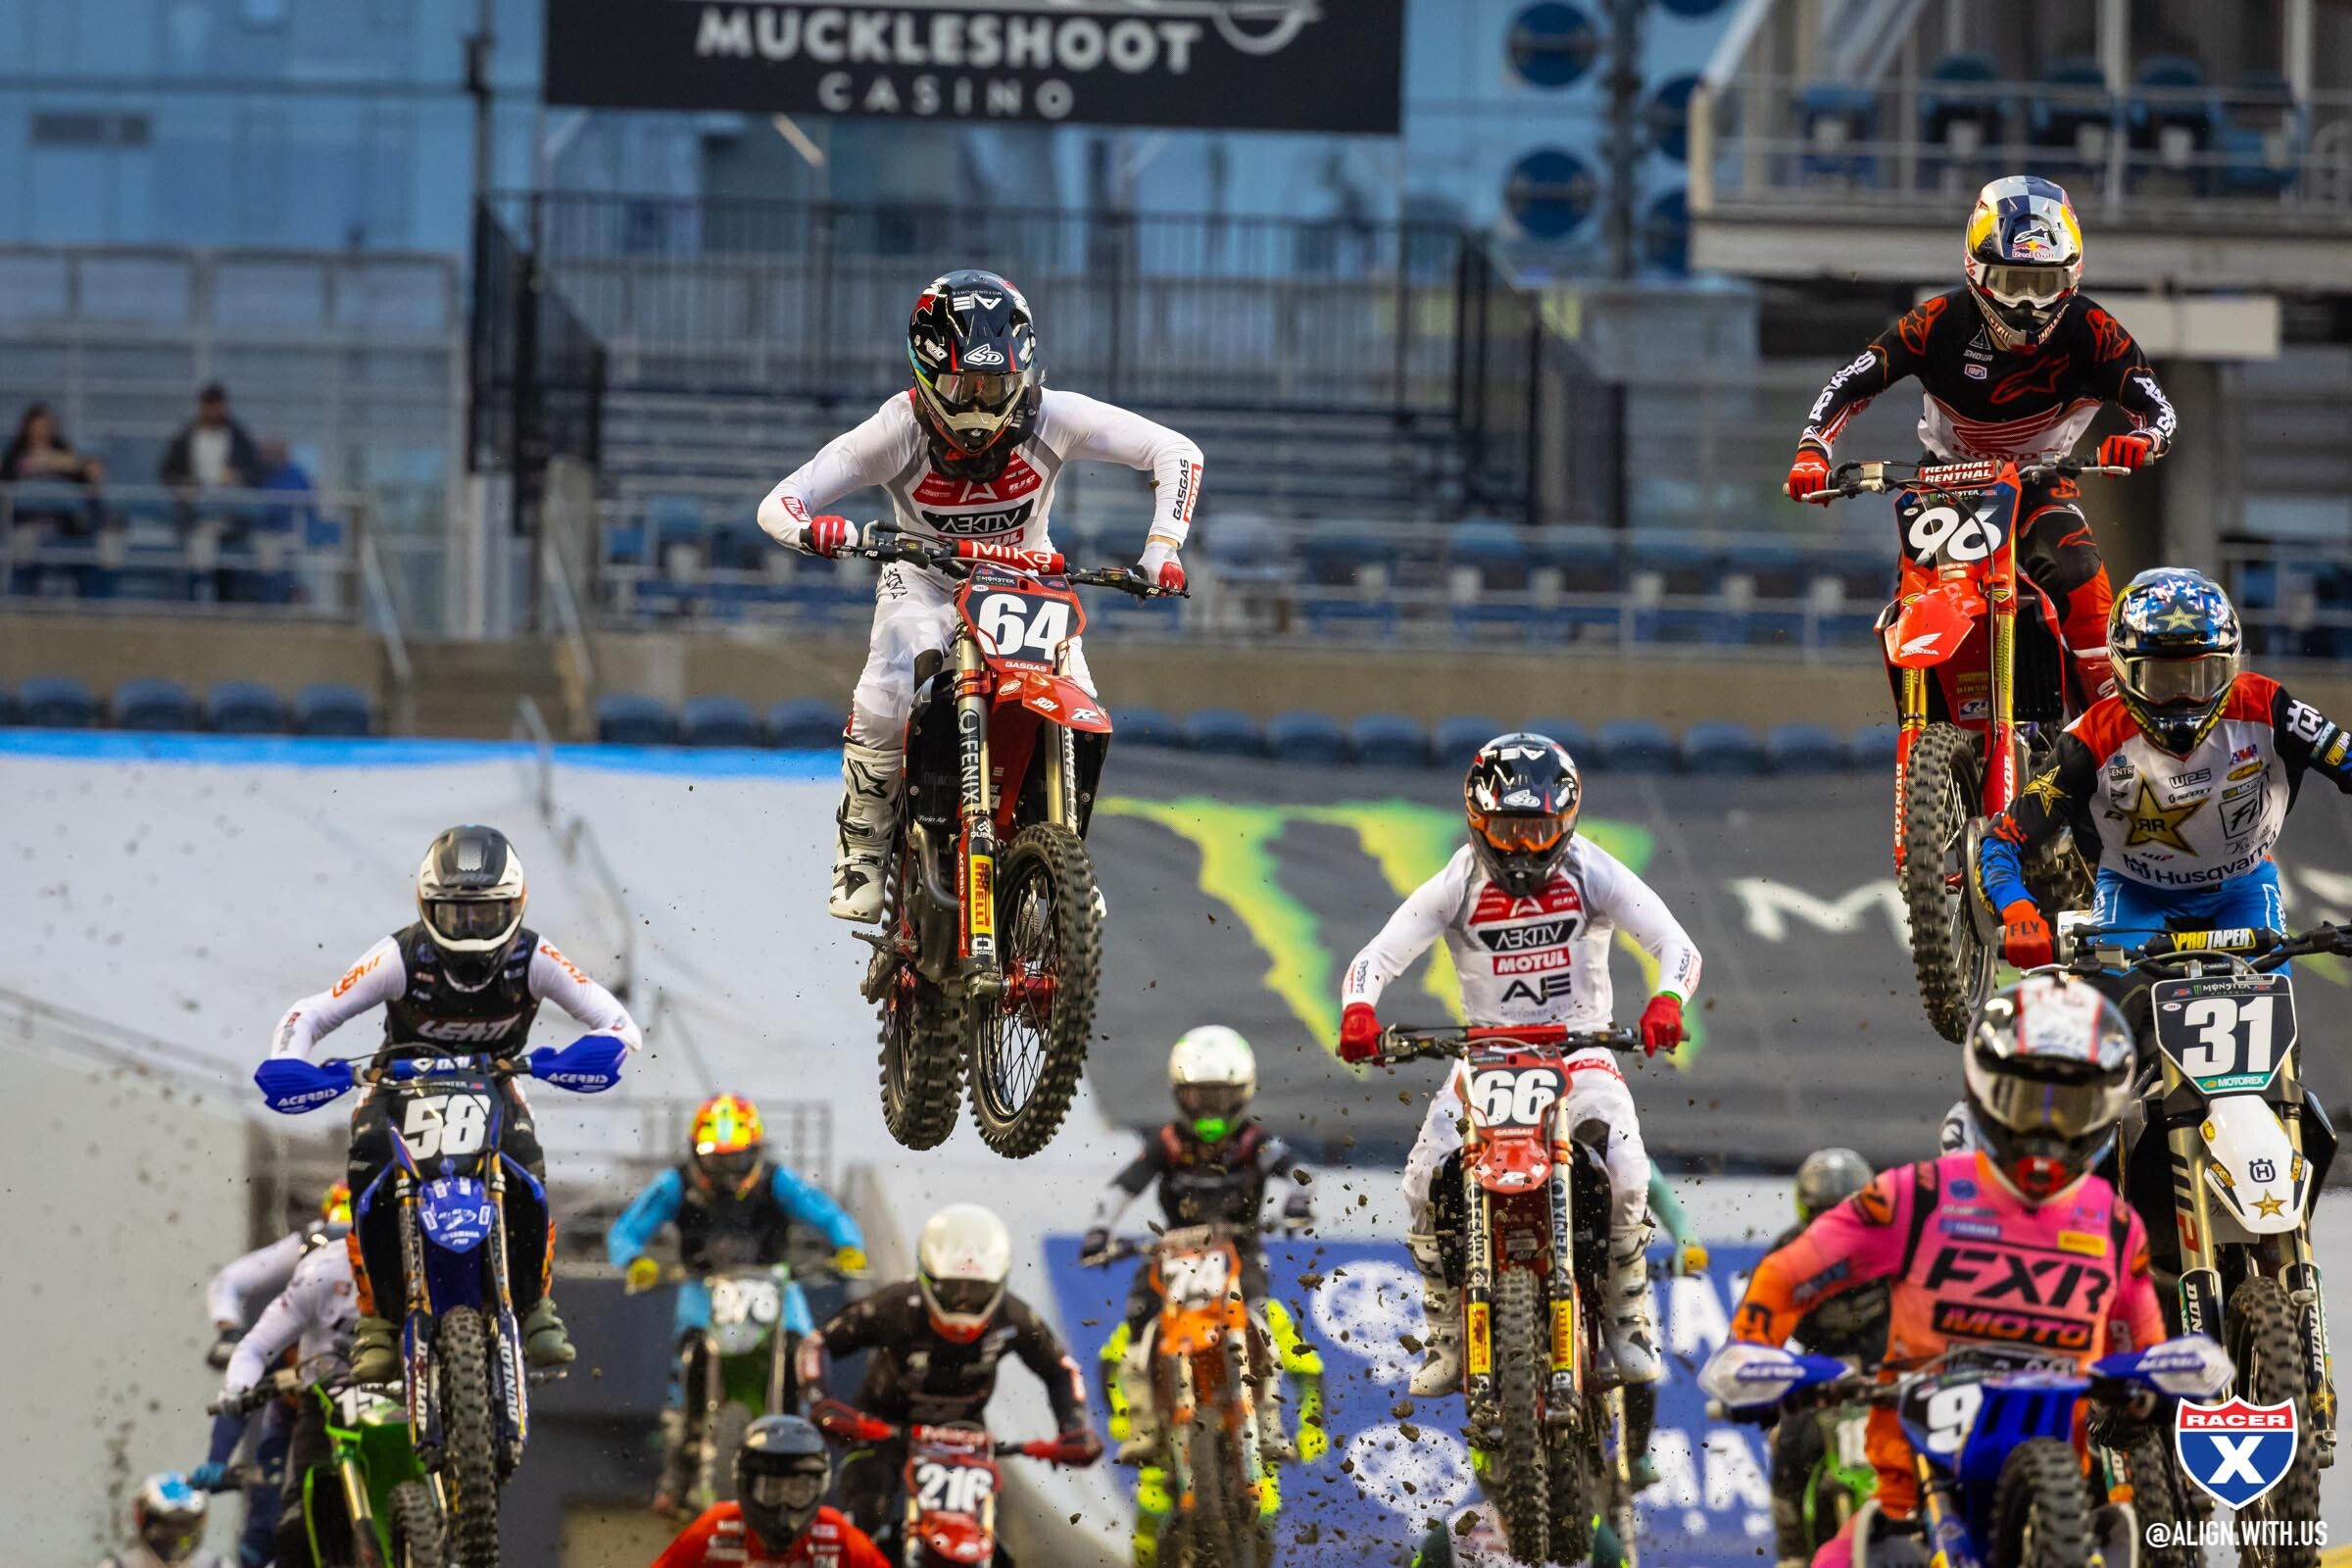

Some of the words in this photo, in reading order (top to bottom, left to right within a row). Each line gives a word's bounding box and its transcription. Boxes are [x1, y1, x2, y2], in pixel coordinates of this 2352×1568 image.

[695, 9, 1203, 74] MUCKLESHOOT
[817, 72, 1074, 119] CASINO
[1173, 458, 1190, 520] GASGAS
[1924, 461, 1992, 474] RENTHAL
[1925, 468, 1992, 483] RENTHAL
[1909, 506, 2002, 566] 96
[976, 593, 1070, 661] 64
[1004, 661, 1048, 672] GASGAS
[959, 740, 979, 804] FENIX
[1894, 762, 1903, 848] DUNLOP
[2155, 830, 2278, 885] Husqvarna
[2010, 919, 2040, 938] FLY
[2176, 928, 2252, 952] PROTAPER
[1496, 951, 1568, 973] MOTUL
[2181, 996, 2274, 1077] 31
[277, 1088, 338, 1107] ACERBIS
[547, 1072, 610, 1084] ACERBIS
[1470, 1069, 1558, 1127] 66
[2218, 1075, 2265, 1088] MOTOREX
[403, 1093, 491, 1161] 58
[1925, 1247, 2112, 1314] FXR
[1940, 1307, 2089, 1347] MOTO
[2184, 1281, 2204, 1335] DUN
